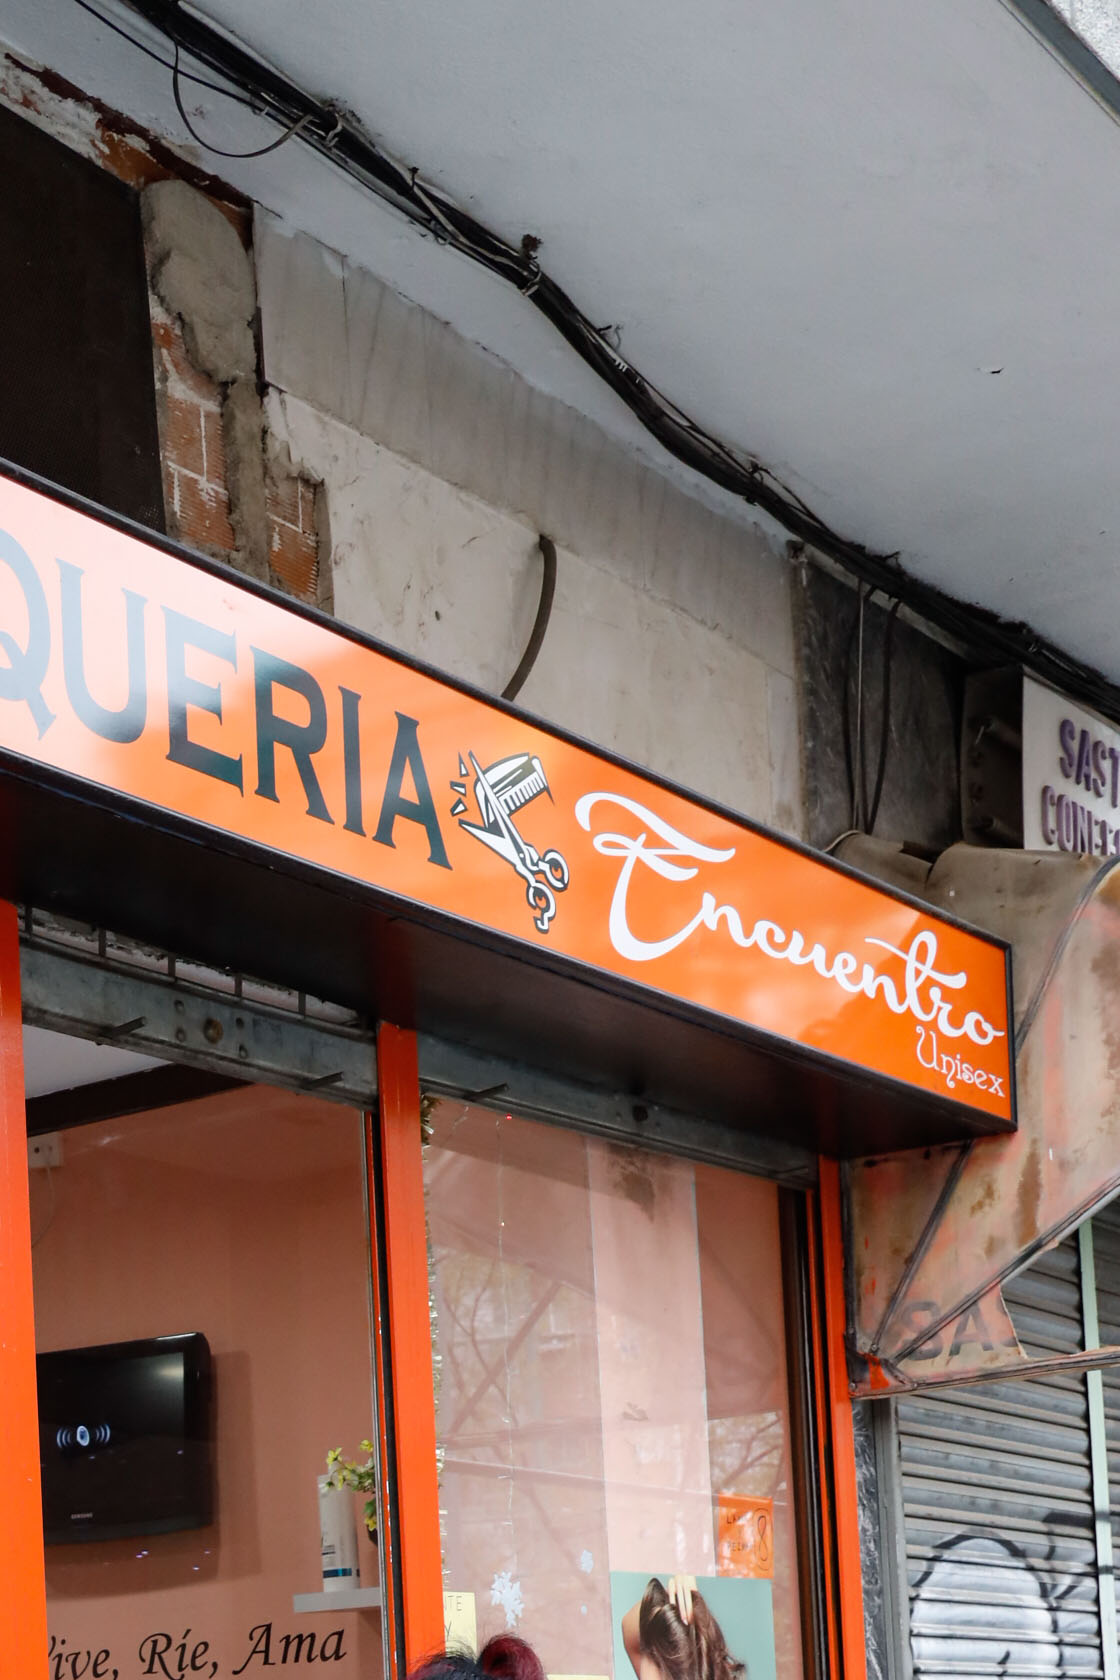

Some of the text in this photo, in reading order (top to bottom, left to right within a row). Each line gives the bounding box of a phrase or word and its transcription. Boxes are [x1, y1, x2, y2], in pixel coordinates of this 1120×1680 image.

[574, 791, 1005, 1046] Encuentro
[915, 1025, 1005, 1098] Unisex
[232, 1622, 348, 1676] Ama
